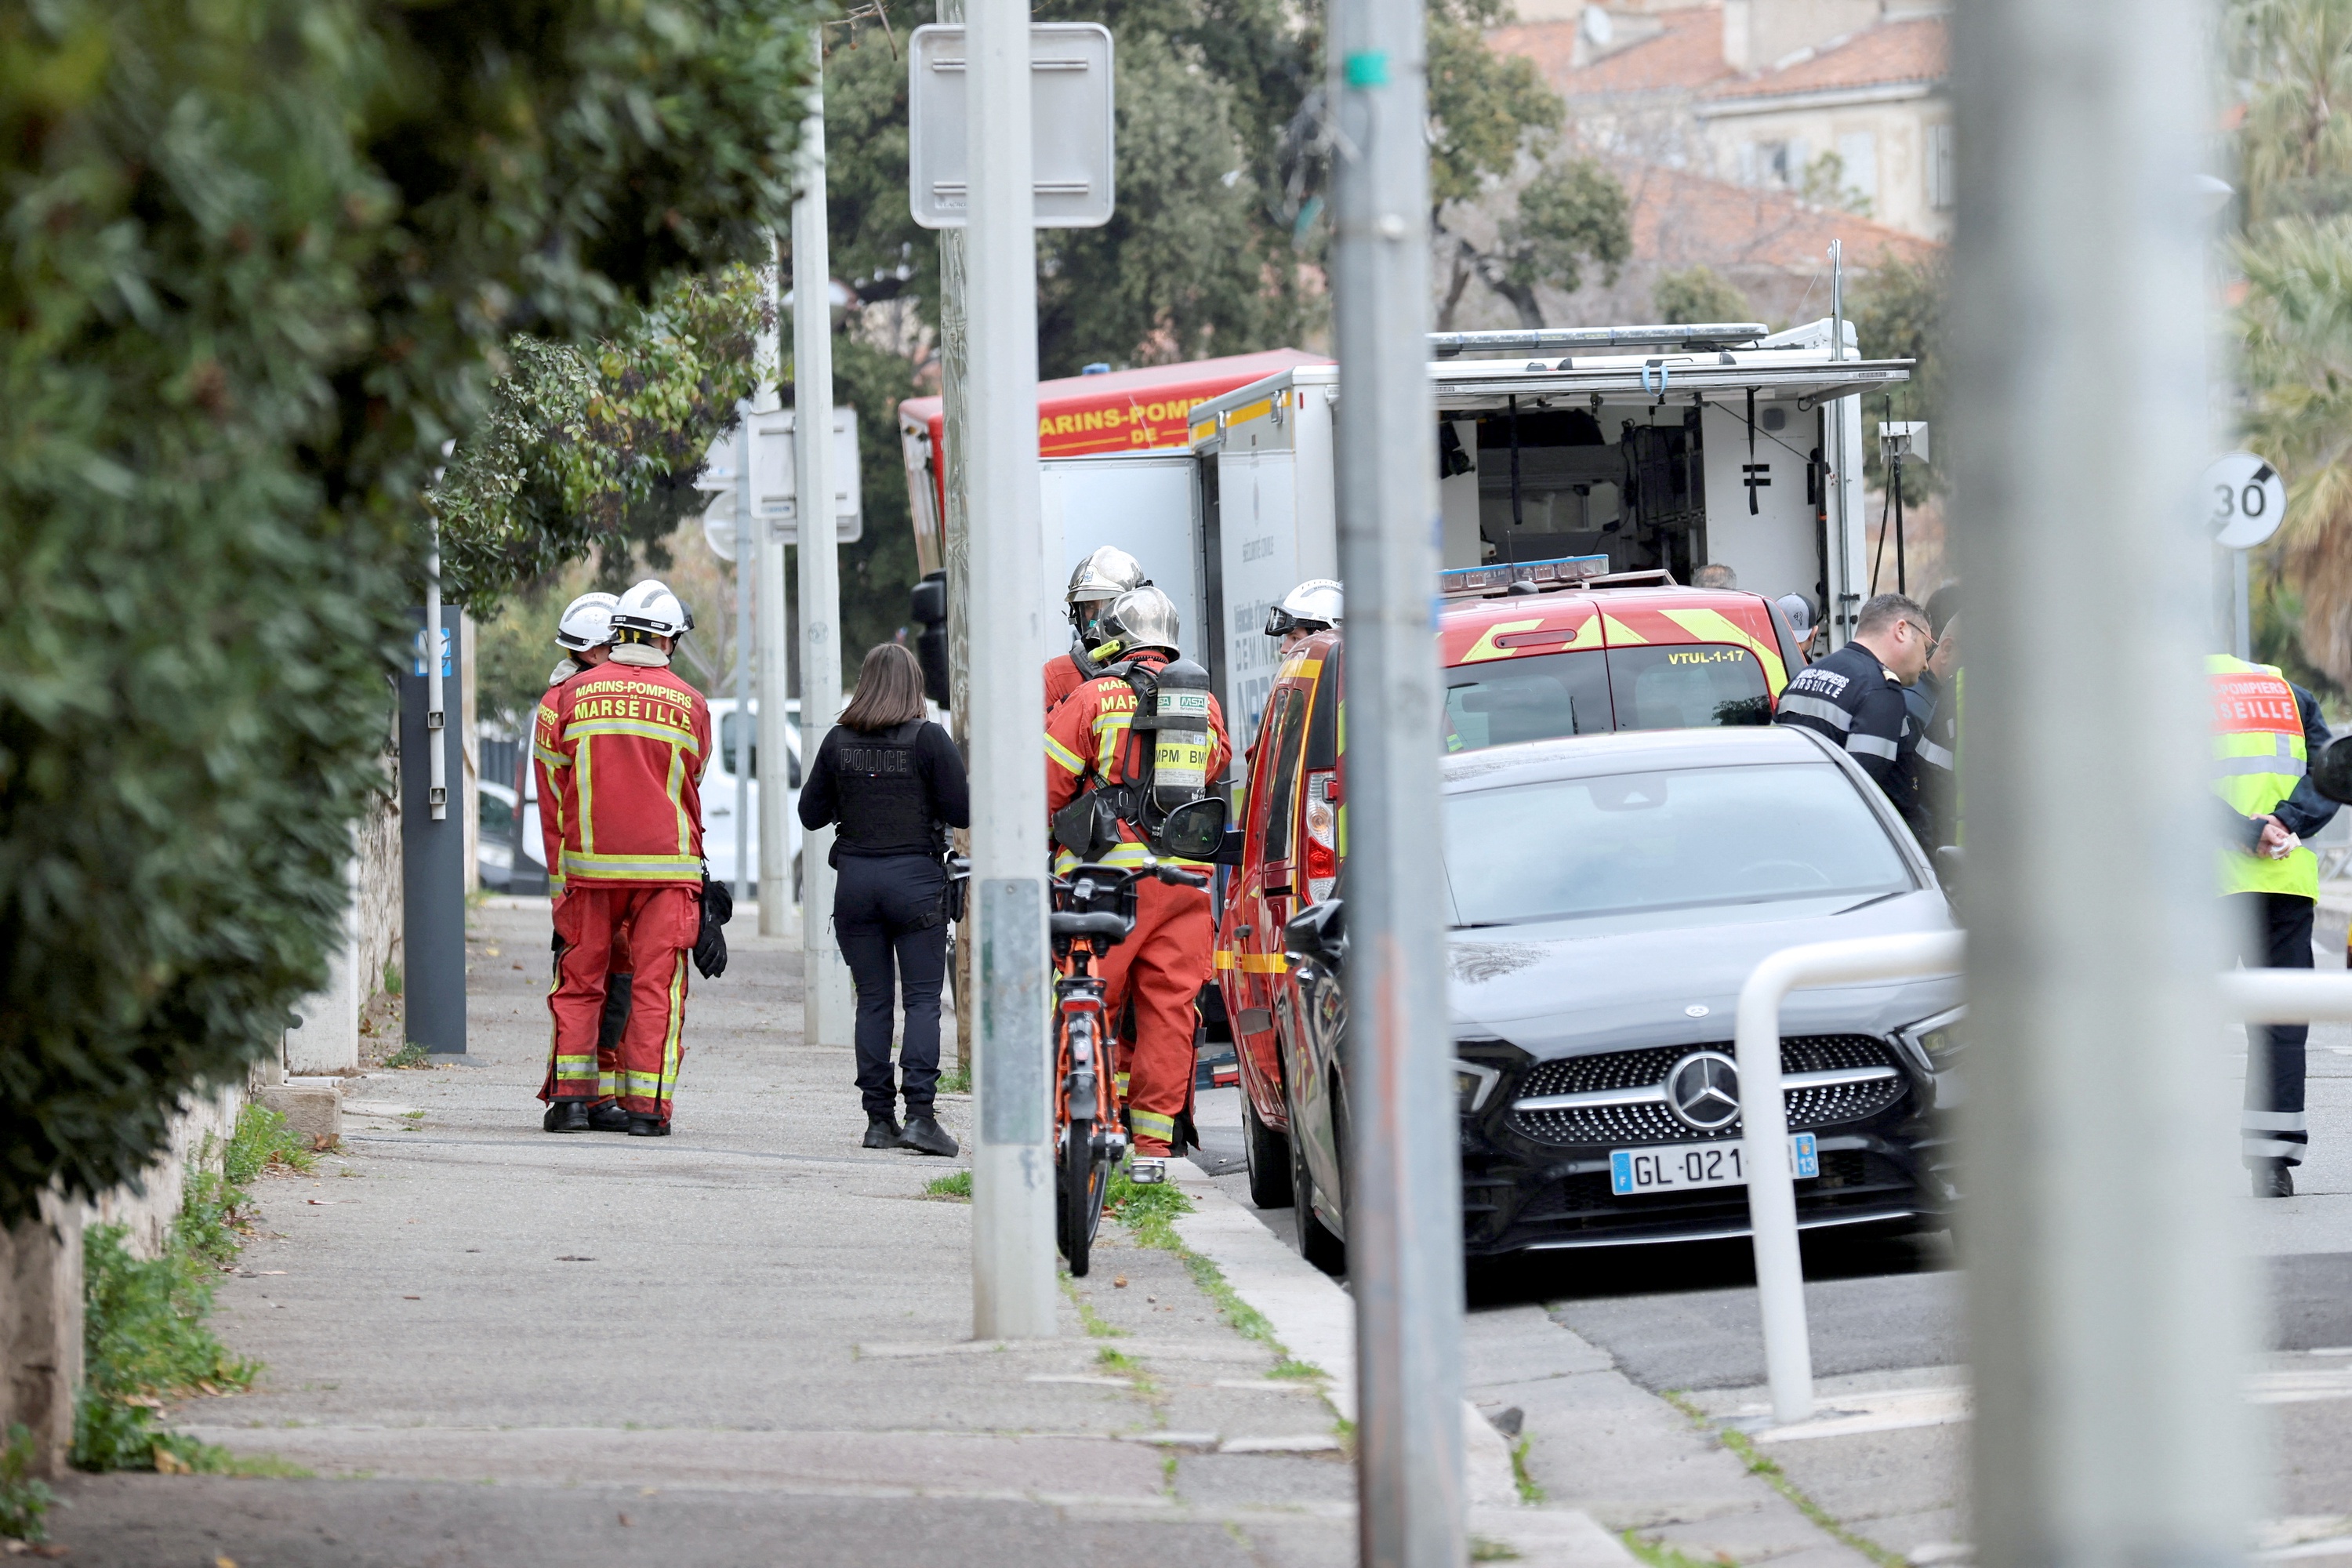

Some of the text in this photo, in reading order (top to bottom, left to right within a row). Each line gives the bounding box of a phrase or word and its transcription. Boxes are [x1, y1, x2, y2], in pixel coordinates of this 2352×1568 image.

[1039, 395, 1214, 437] ARINS-POM
[1131, 427, 1157, 444] DE
[2213, 483, 2267, 517] 30
[1668, 650, 1745, 665] VTUL-1-17
[575, 681, 692, 709] MARINS-POMPIERS
[1180, 697, 1205, 707] MSA
[575, 699, 691, 730] MARSEILLE
[840, 748, 906, 772] POLICE
[1189, 750, 1206, 764] BM
[1799, 1157, 1815, 1173] 13
[1619, 1176, 1626, 1187] F
